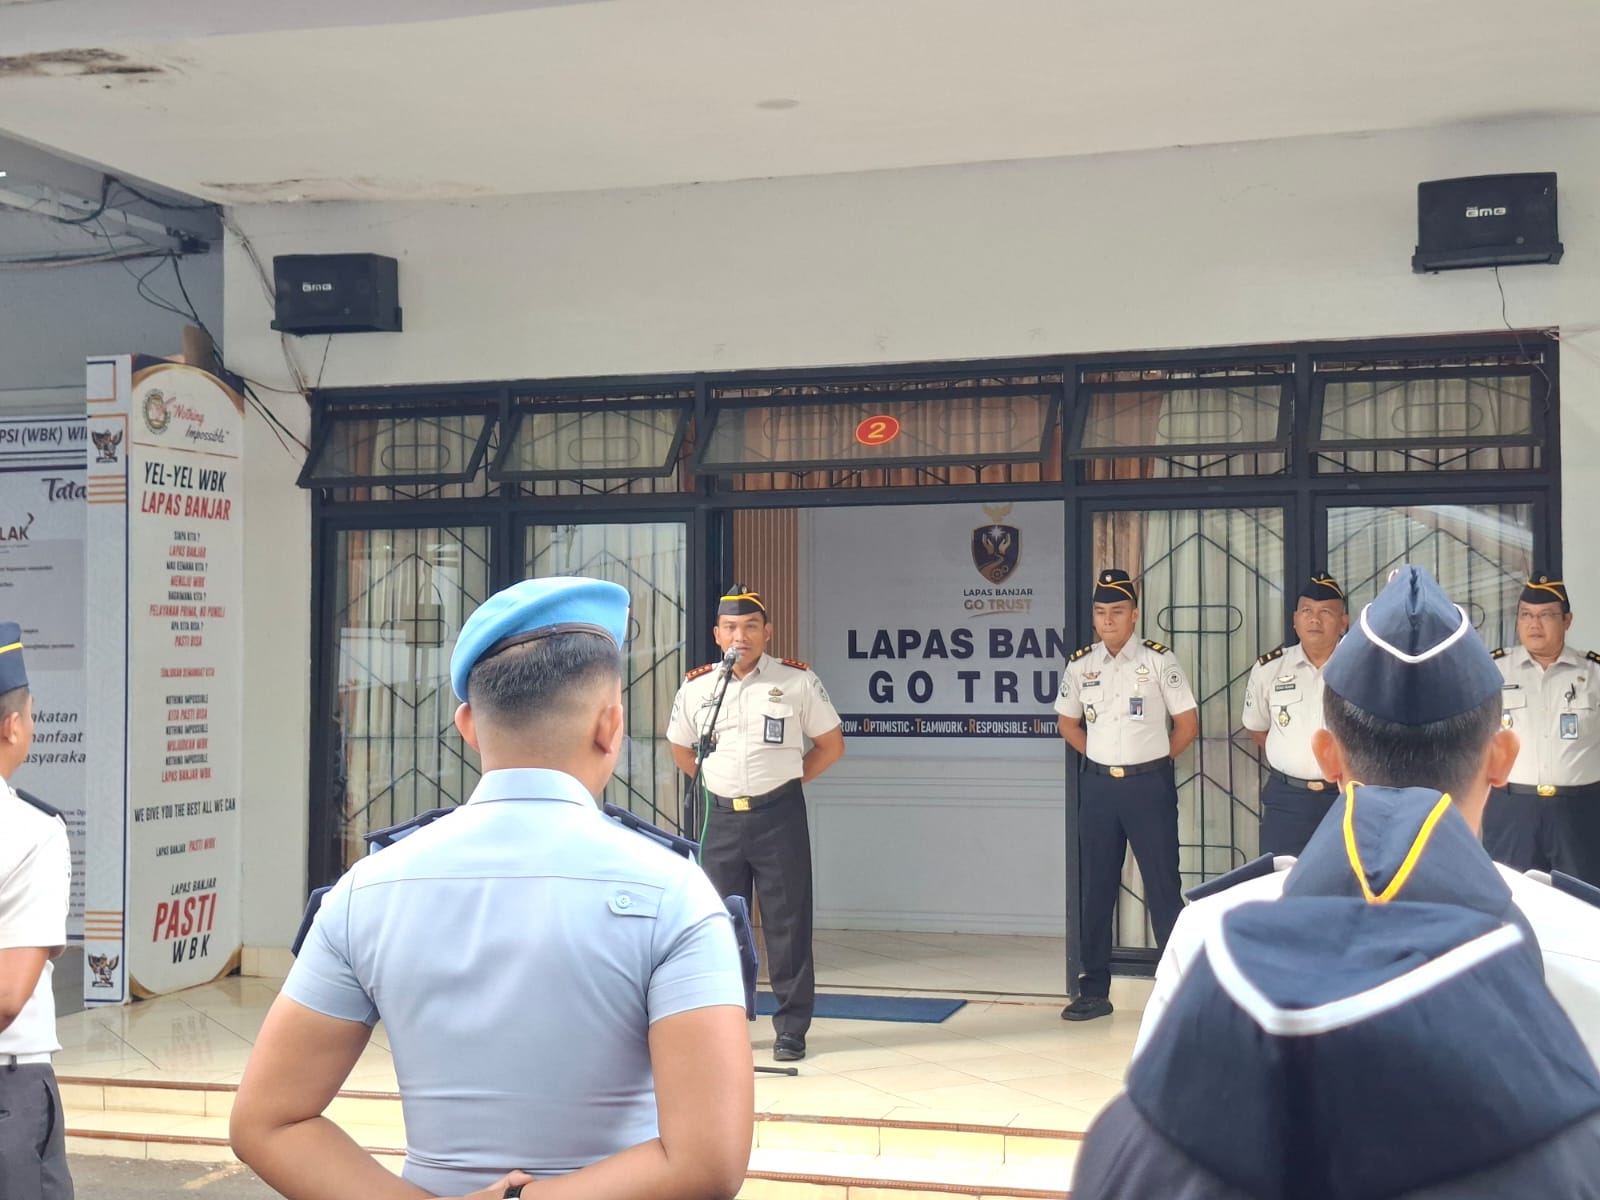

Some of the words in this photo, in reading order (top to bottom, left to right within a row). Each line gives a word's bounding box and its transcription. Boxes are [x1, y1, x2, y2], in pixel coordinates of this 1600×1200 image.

[22, 425, 63, 447] (WBK)
[868, 422, 886, 439] 2
[145, 461, 193, 489] YEL-YEL
[199, 468, 227, 492] WBK
[41, 477, 87, 502] Tata
[141, 491, 182, 516] LAPAS
[184, 495, 231, 520] BANJAR
[963, 588, 993, 597] LAPAS
[995, 587, 1033, 597] BANJAR
[964, 599, 985, 610] GO
[988, 598, 1032, 611] TRUST
[848, 628, 974, 659] LAPAS
[989, 628, 1065, 659] BAN
[869, 670, 933, 703] GO
[958, 670, 1058, 703] TRU
[863, 718, 910, 733] OPTIMISTIC
[914, 718, 964, 734] TEAMWORK
[968, 718, 1028, 734] RESPONSIBLE
[1033, 719, 1059, 734] UNITY
[135, 808, 144, 822] WE
[146, 806, 159, 821] GIVE
[161, 804, 173, 819] YOU
[174, 803, 185, 817] THE
[187, 801, 201, 816] BEST
[202, 800, 213, 814] ALL
[214, 799, 224, 813] WE
[171, 882, 191, 895] LAPAS
[193, 877, 217, 891] BANJAR
[152, 892, 217, 942] PASTI
[172, 934, 211, 964] WBK
